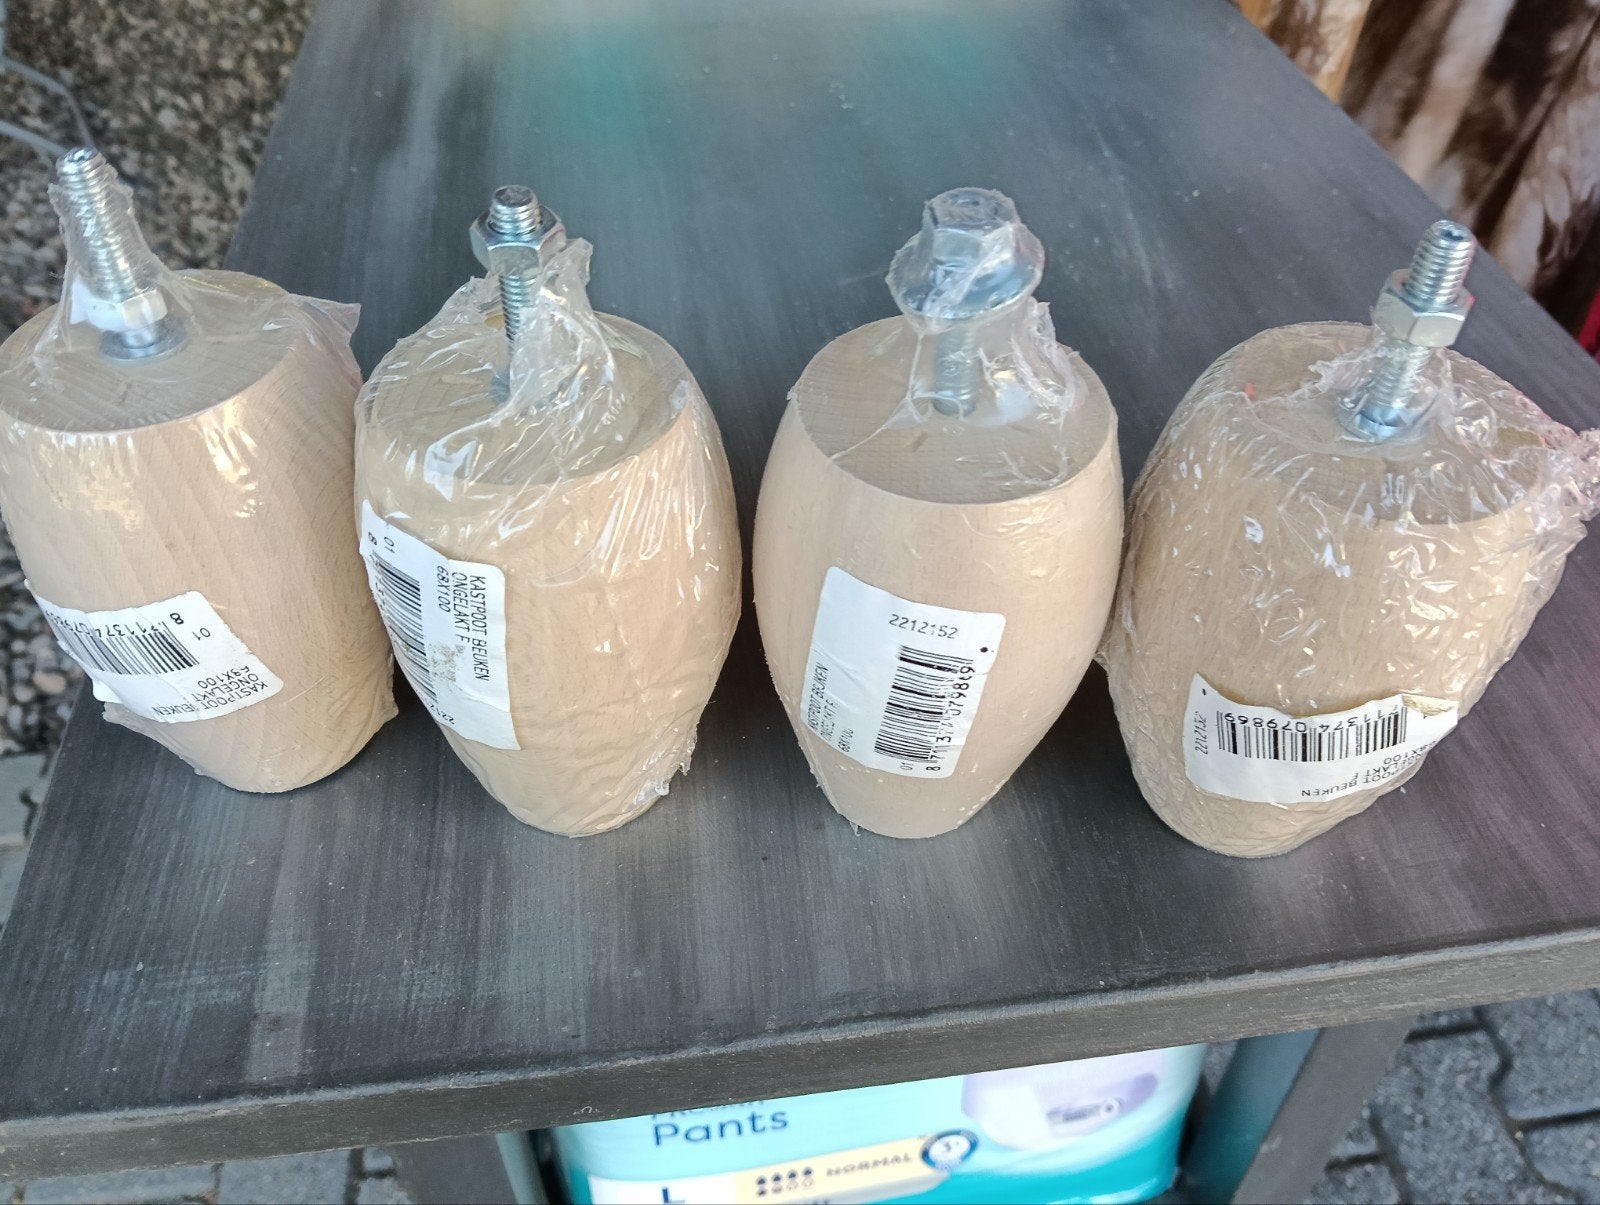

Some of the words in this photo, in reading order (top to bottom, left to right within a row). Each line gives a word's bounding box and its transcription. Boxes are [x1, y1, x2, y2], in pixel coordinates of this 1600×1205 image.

[436, 565, 452, 613] 68X100
[452, 571, 471, 633] ONGELAKT
[170, 611, 185, 626] 8
[470, 575, 488, 635] KASTPOOT
[191, 626, 212, 641] 01
[888, 613, 959, 640] 2212152
[472, 637, 490, 682] BEUKEN
[199, 681, 269, 711] KASTPOOT
[1223, 711, 1308, 733] 079869
[1383, 740, 1437, 765] 8X100
[1301, 779, 1359, 797] BEUKEN
[652, 1110, 789, 1147] Pants
[826, 1151, 914, 1178] NORMAL
